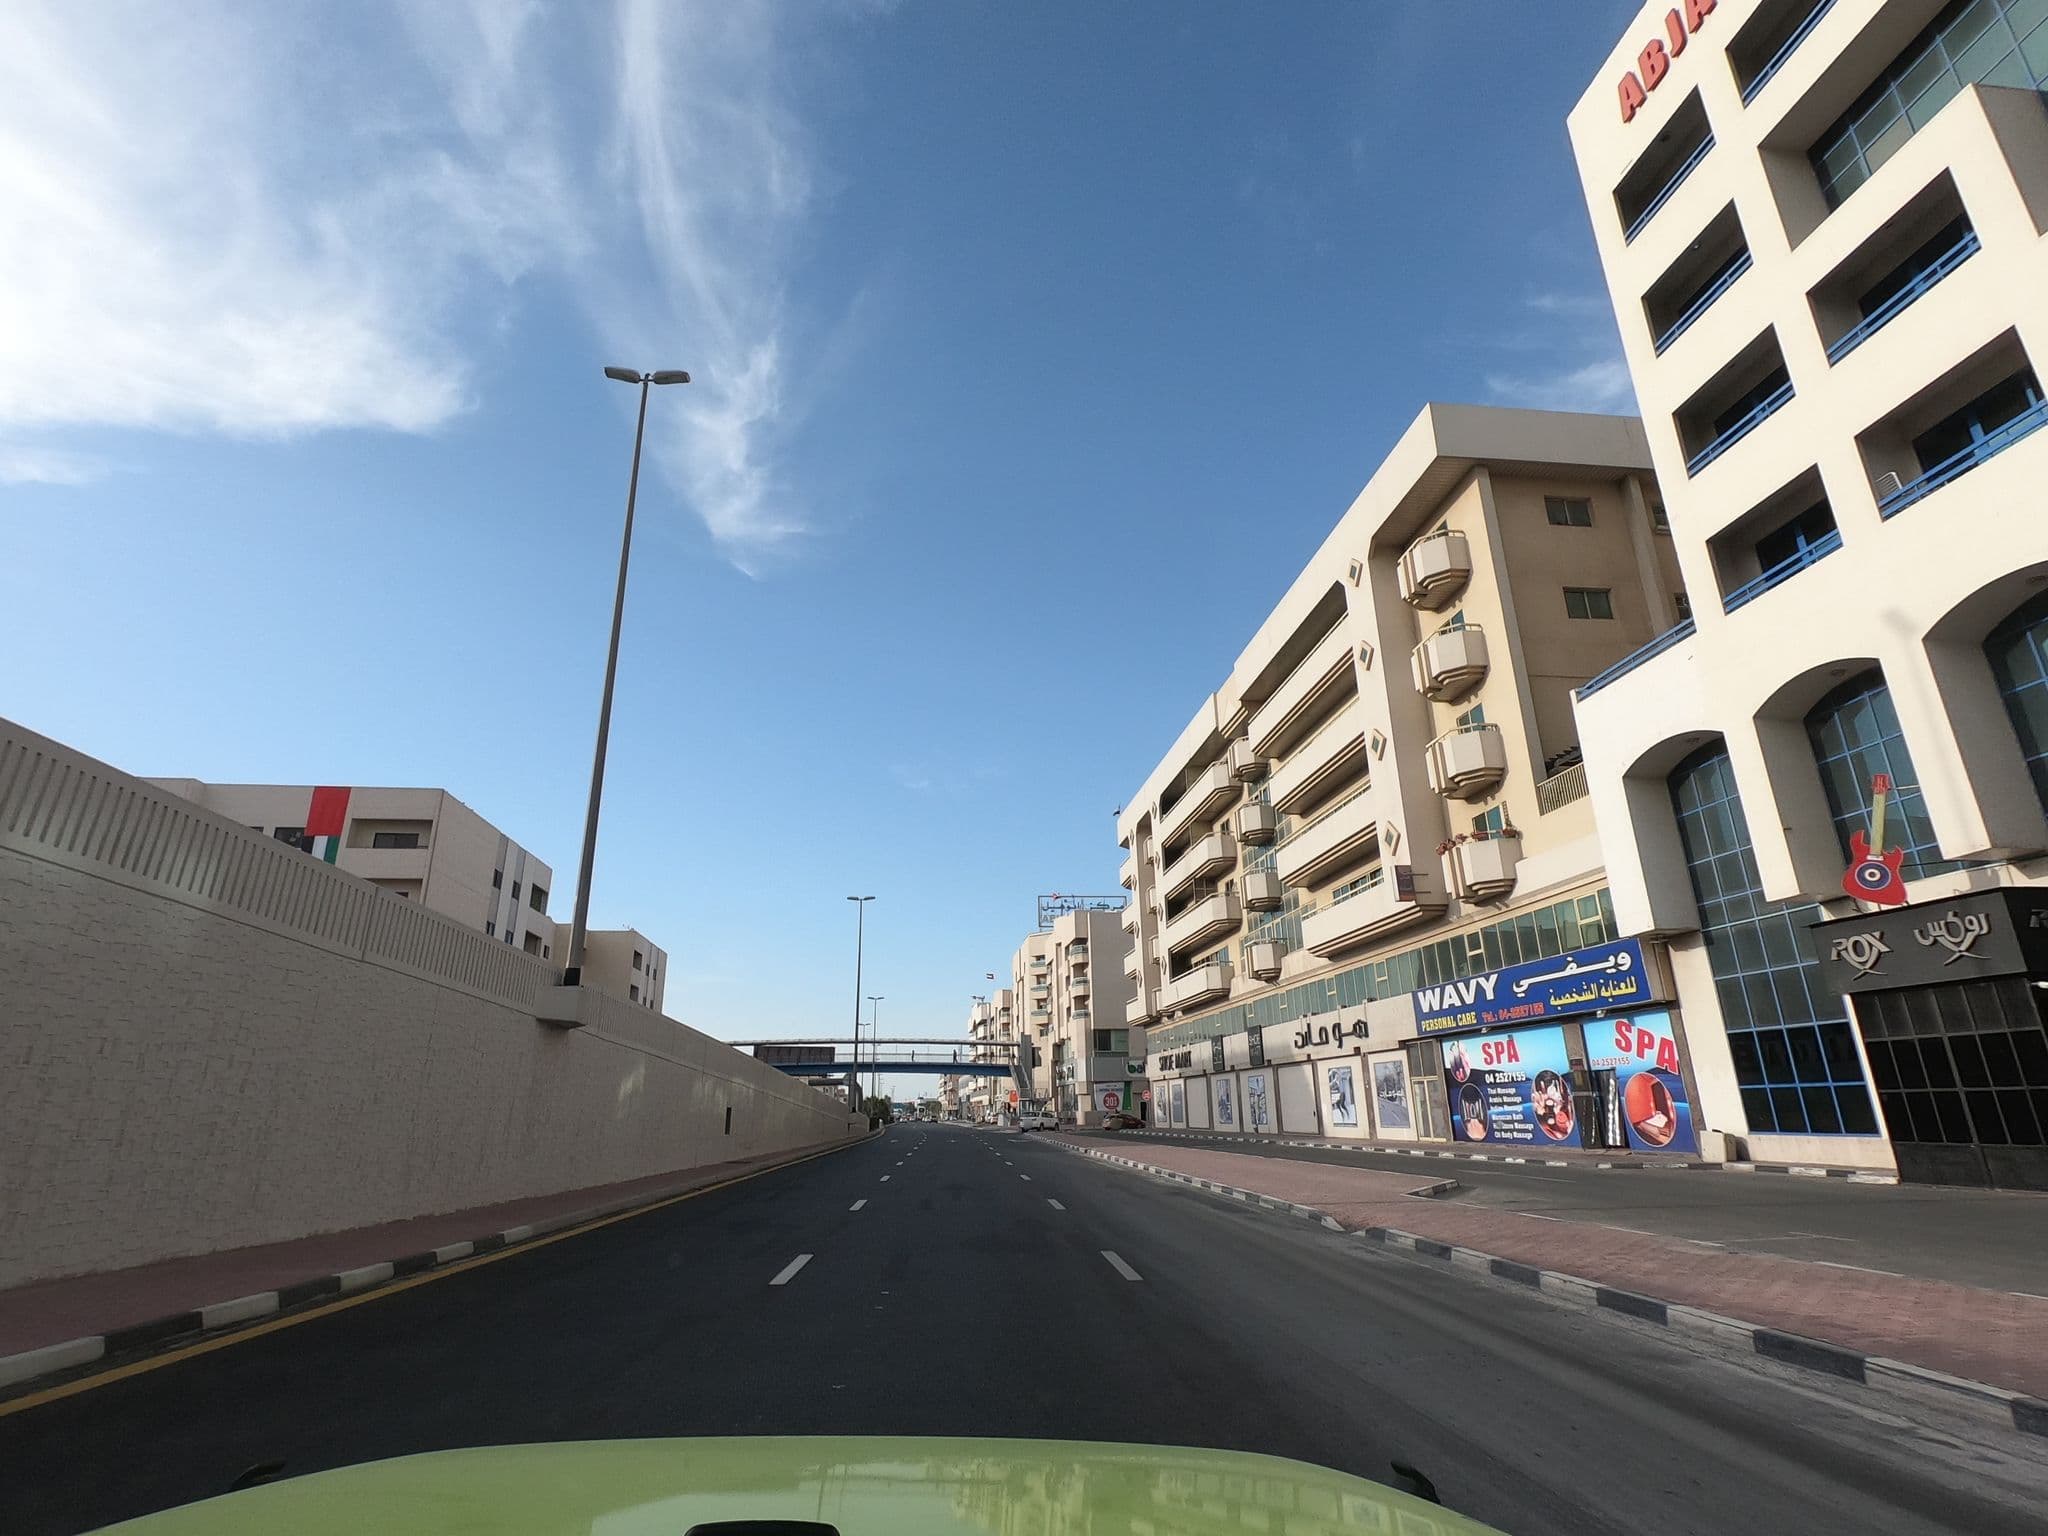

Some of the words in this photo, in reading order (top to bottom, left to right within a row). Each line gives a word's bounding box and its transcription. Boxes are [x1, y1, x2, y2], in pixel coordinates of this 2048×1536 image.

[1512, 952, 1631, 998] ويفي
[1600, 976, 1637, 1002] للعناية
[1417, 974, 1498, 1013] WAVY
[1548, 982, 1598, 1010] الشخصية
[1421, 1015, 1456, 1032] PERSONAL
[1457, 1012, 1477, 1026] CARE
[1481, 1038, 1520, 1066] SPA
[1615, 1019, 1679, 1074] SPA
[1485, 1073, 1494, 1083] 04
[1495, 1070, 1526, 1083] 2527155
